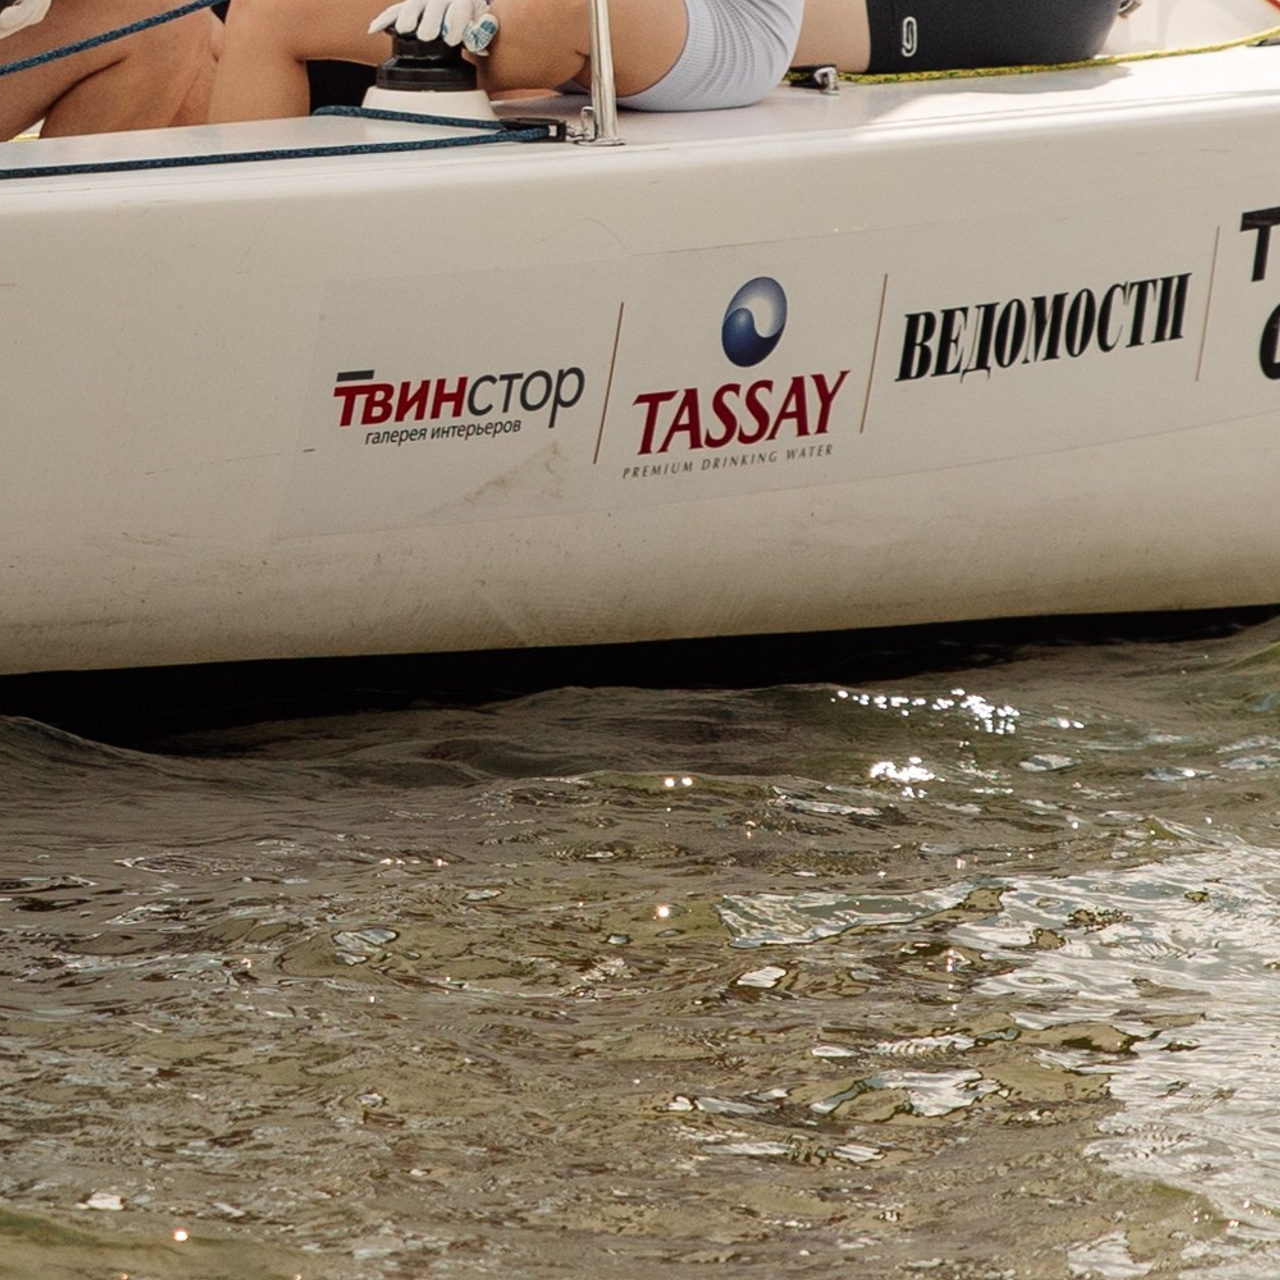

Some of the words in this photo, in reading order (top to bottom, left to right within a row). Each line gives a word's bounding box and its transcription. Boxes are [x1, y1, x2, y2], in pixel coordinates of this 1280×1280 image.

[894, 272, 1192, 384] ВЕДОМОСТИ
[365, 423, 427, 448] галерея
[430, 418, 522, 440] интерьеров
[632, 369, 851, 456] TASSAY
[622, 462, 694, 480] PREMIUM
[701, 450, 779, 471] DRINKING
[786, 443, 834, 460] WATER
